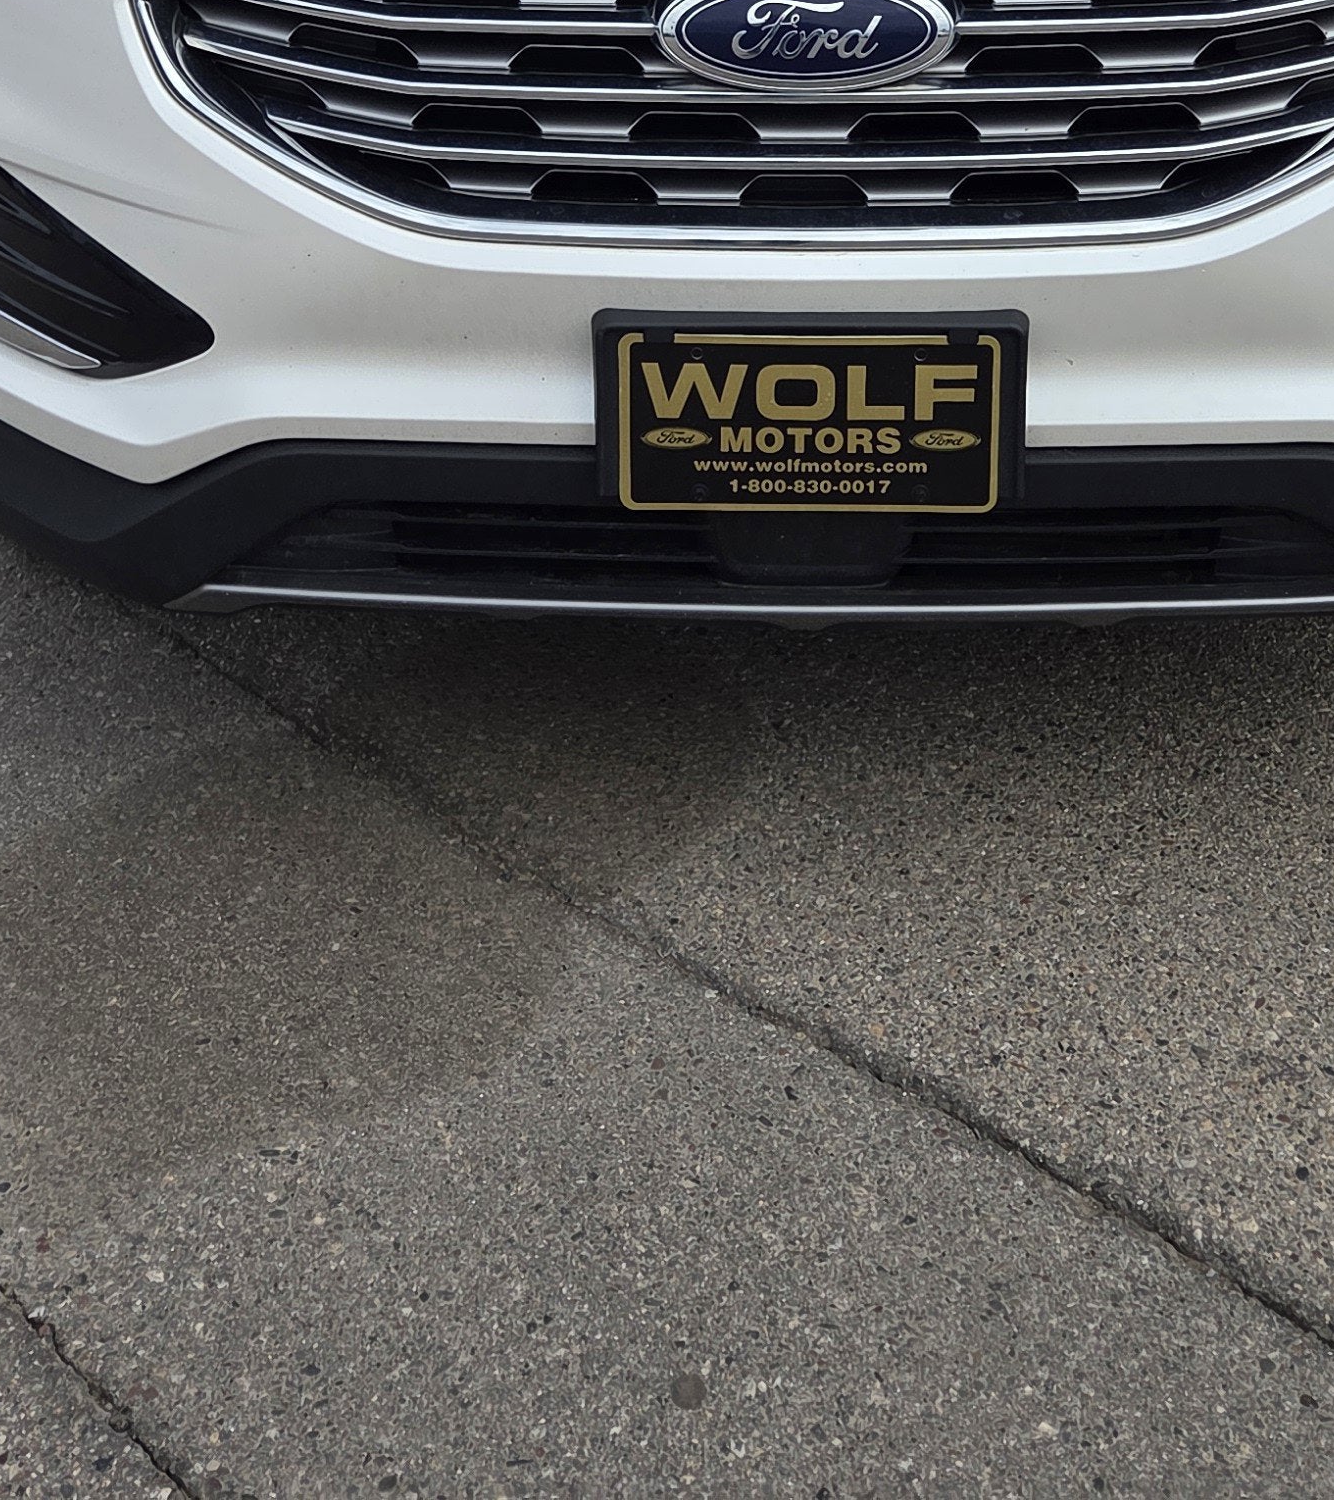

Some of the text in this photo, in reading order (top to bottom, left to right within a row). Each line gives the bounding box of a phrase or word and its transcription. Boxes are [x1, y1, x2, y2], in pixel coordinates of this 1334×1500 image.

[640, 361, 979, 422] WOLF
[655, 430, 696, 446] Ford
[719, 426, 902, 456] MOTORS
[924, 431, 965, 448] Ford
[693, 458, 928, 474] www.wolfmotors.com
[729, 479, 891, 495] 1-800-830-0017
